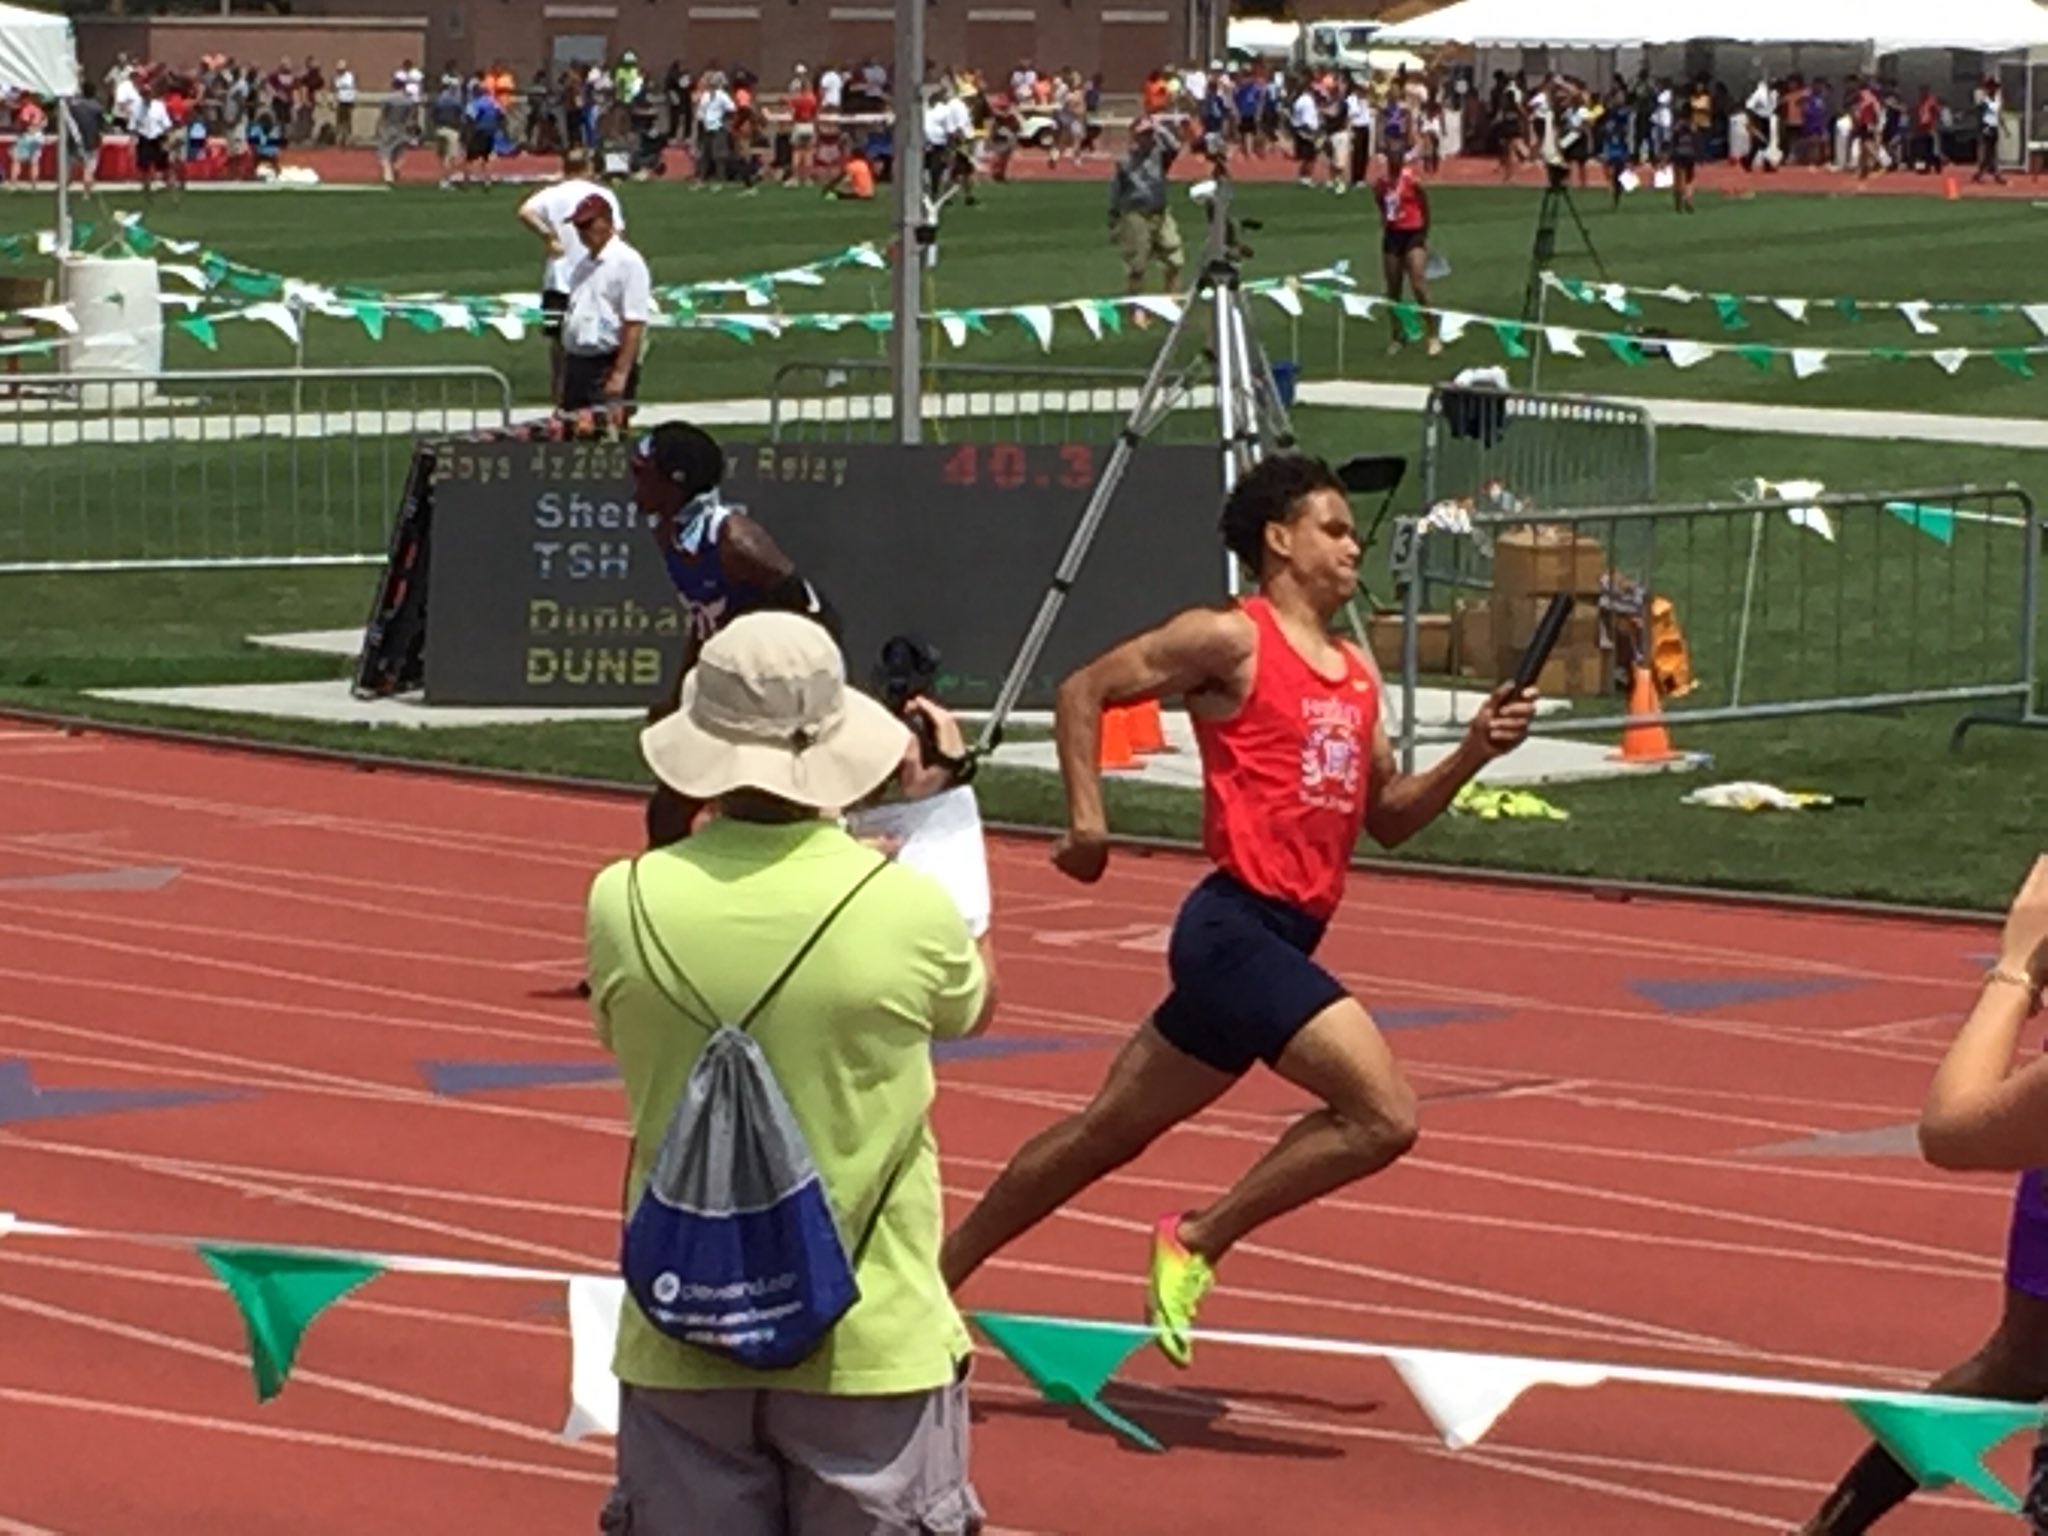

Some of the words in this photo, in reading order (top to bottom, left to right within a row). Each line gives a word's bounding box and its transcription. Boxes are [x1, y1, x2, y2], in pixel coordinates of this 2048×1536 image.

[436, 446, 511, 484] Boys
[757, 447, 848, 488] Relay
[942, 444, 1093, 489] 40.3
[534, 543, 629, 578] TSH
[526, 648, 662, 684] DUNB
